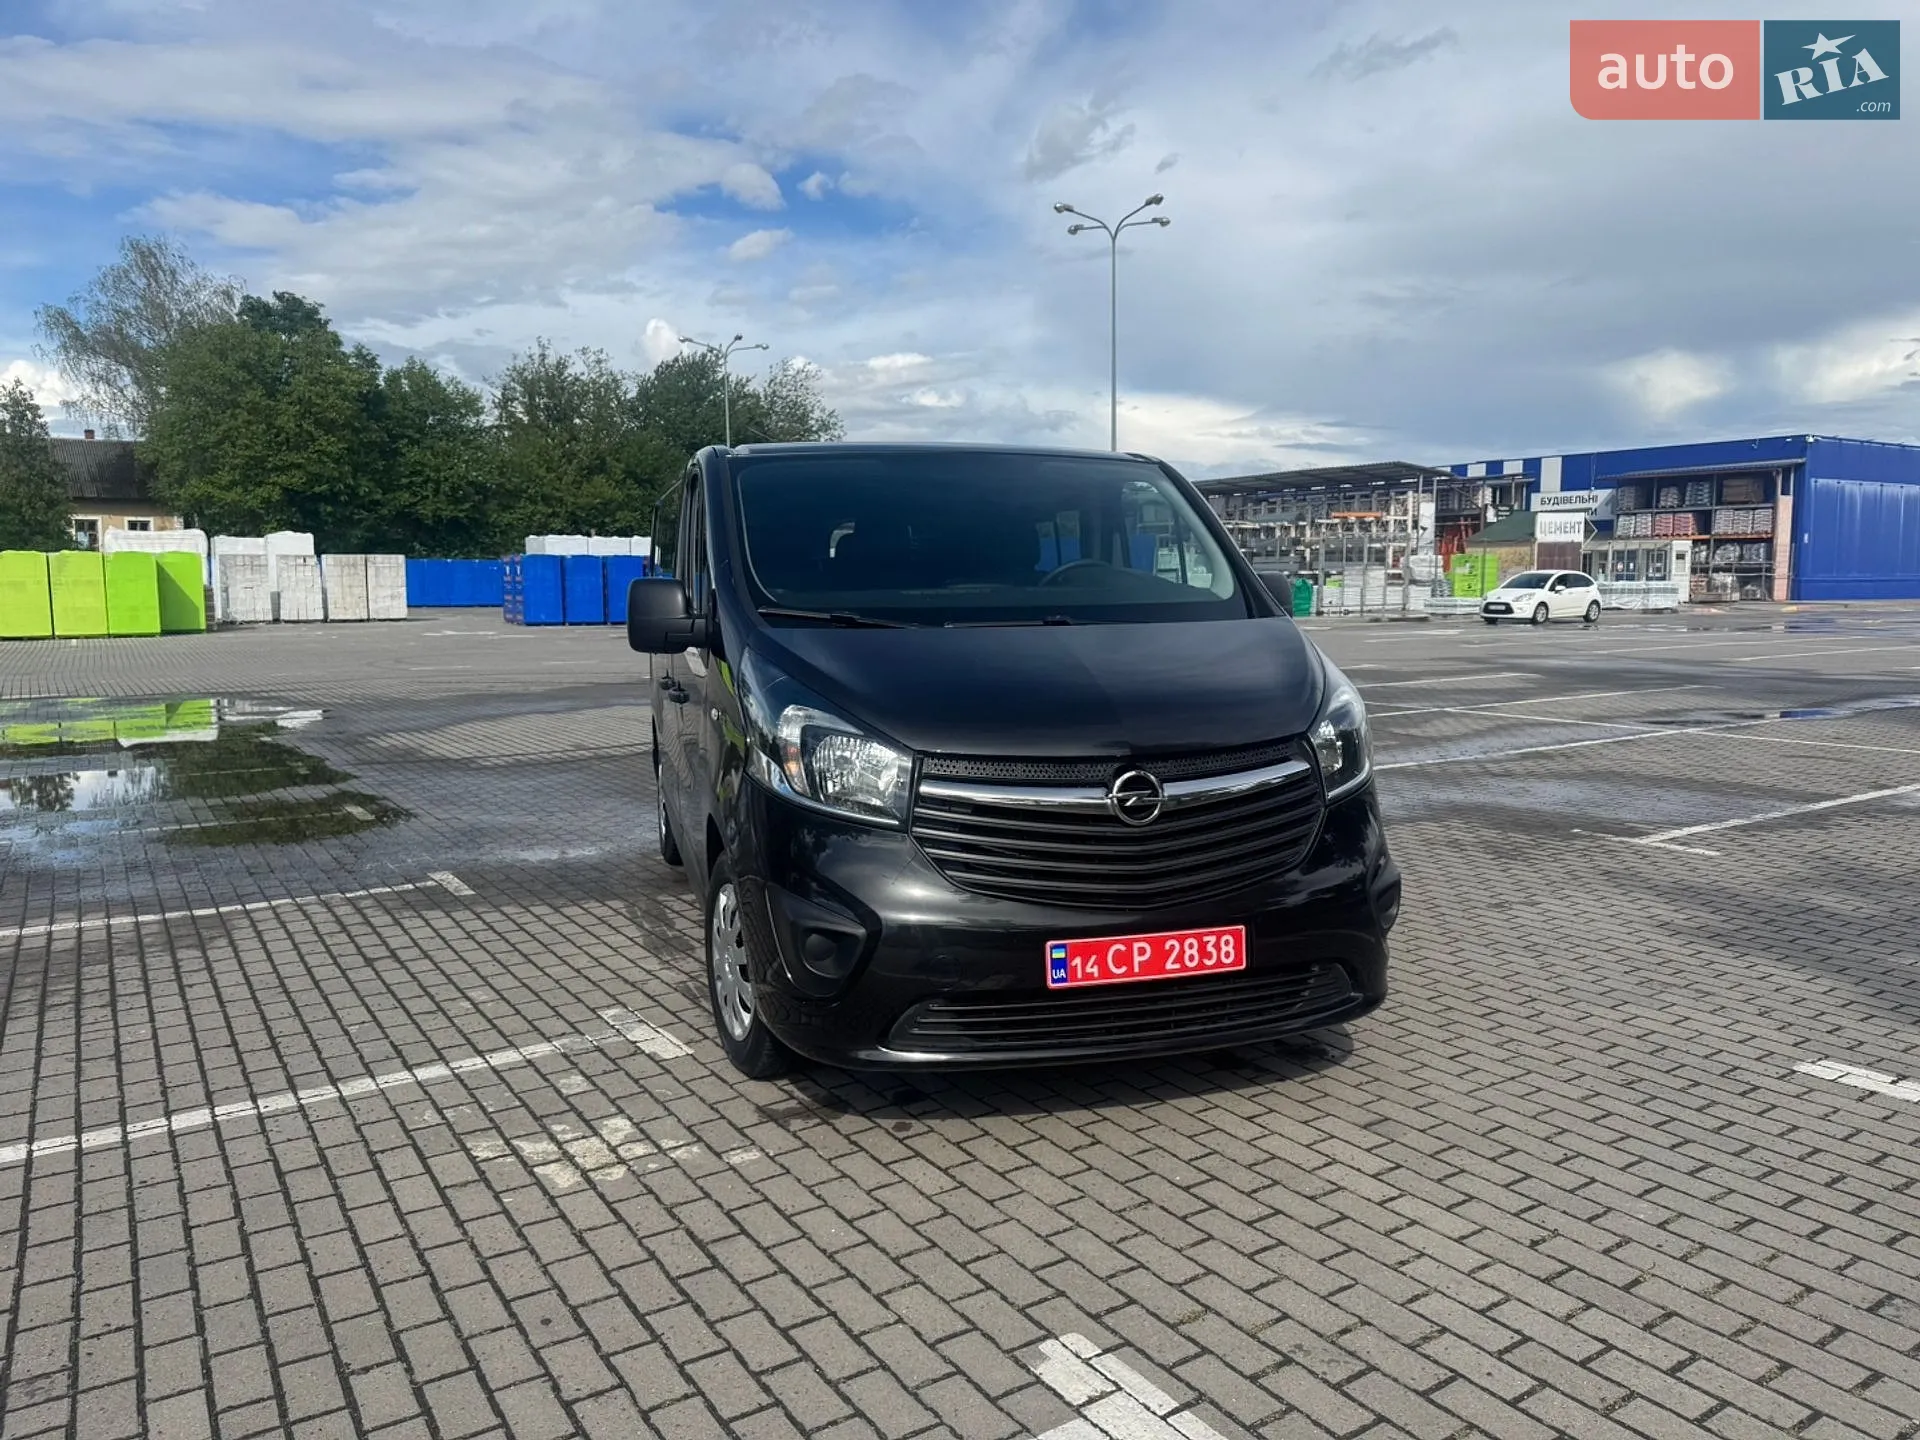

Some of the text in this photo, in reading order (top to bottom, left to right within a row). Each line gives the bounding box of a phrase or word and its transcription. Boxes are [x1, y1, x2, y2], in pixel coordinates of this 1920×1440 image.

[1540, 494, 1599, 506] БУДІВЕЛЬНІ
[1540, 520, 1583, 536] ЦЕМЕНТ
[1071, 934, 1236, 979] 14 CP 2838
[1052, 968, 1066, 979] UA
